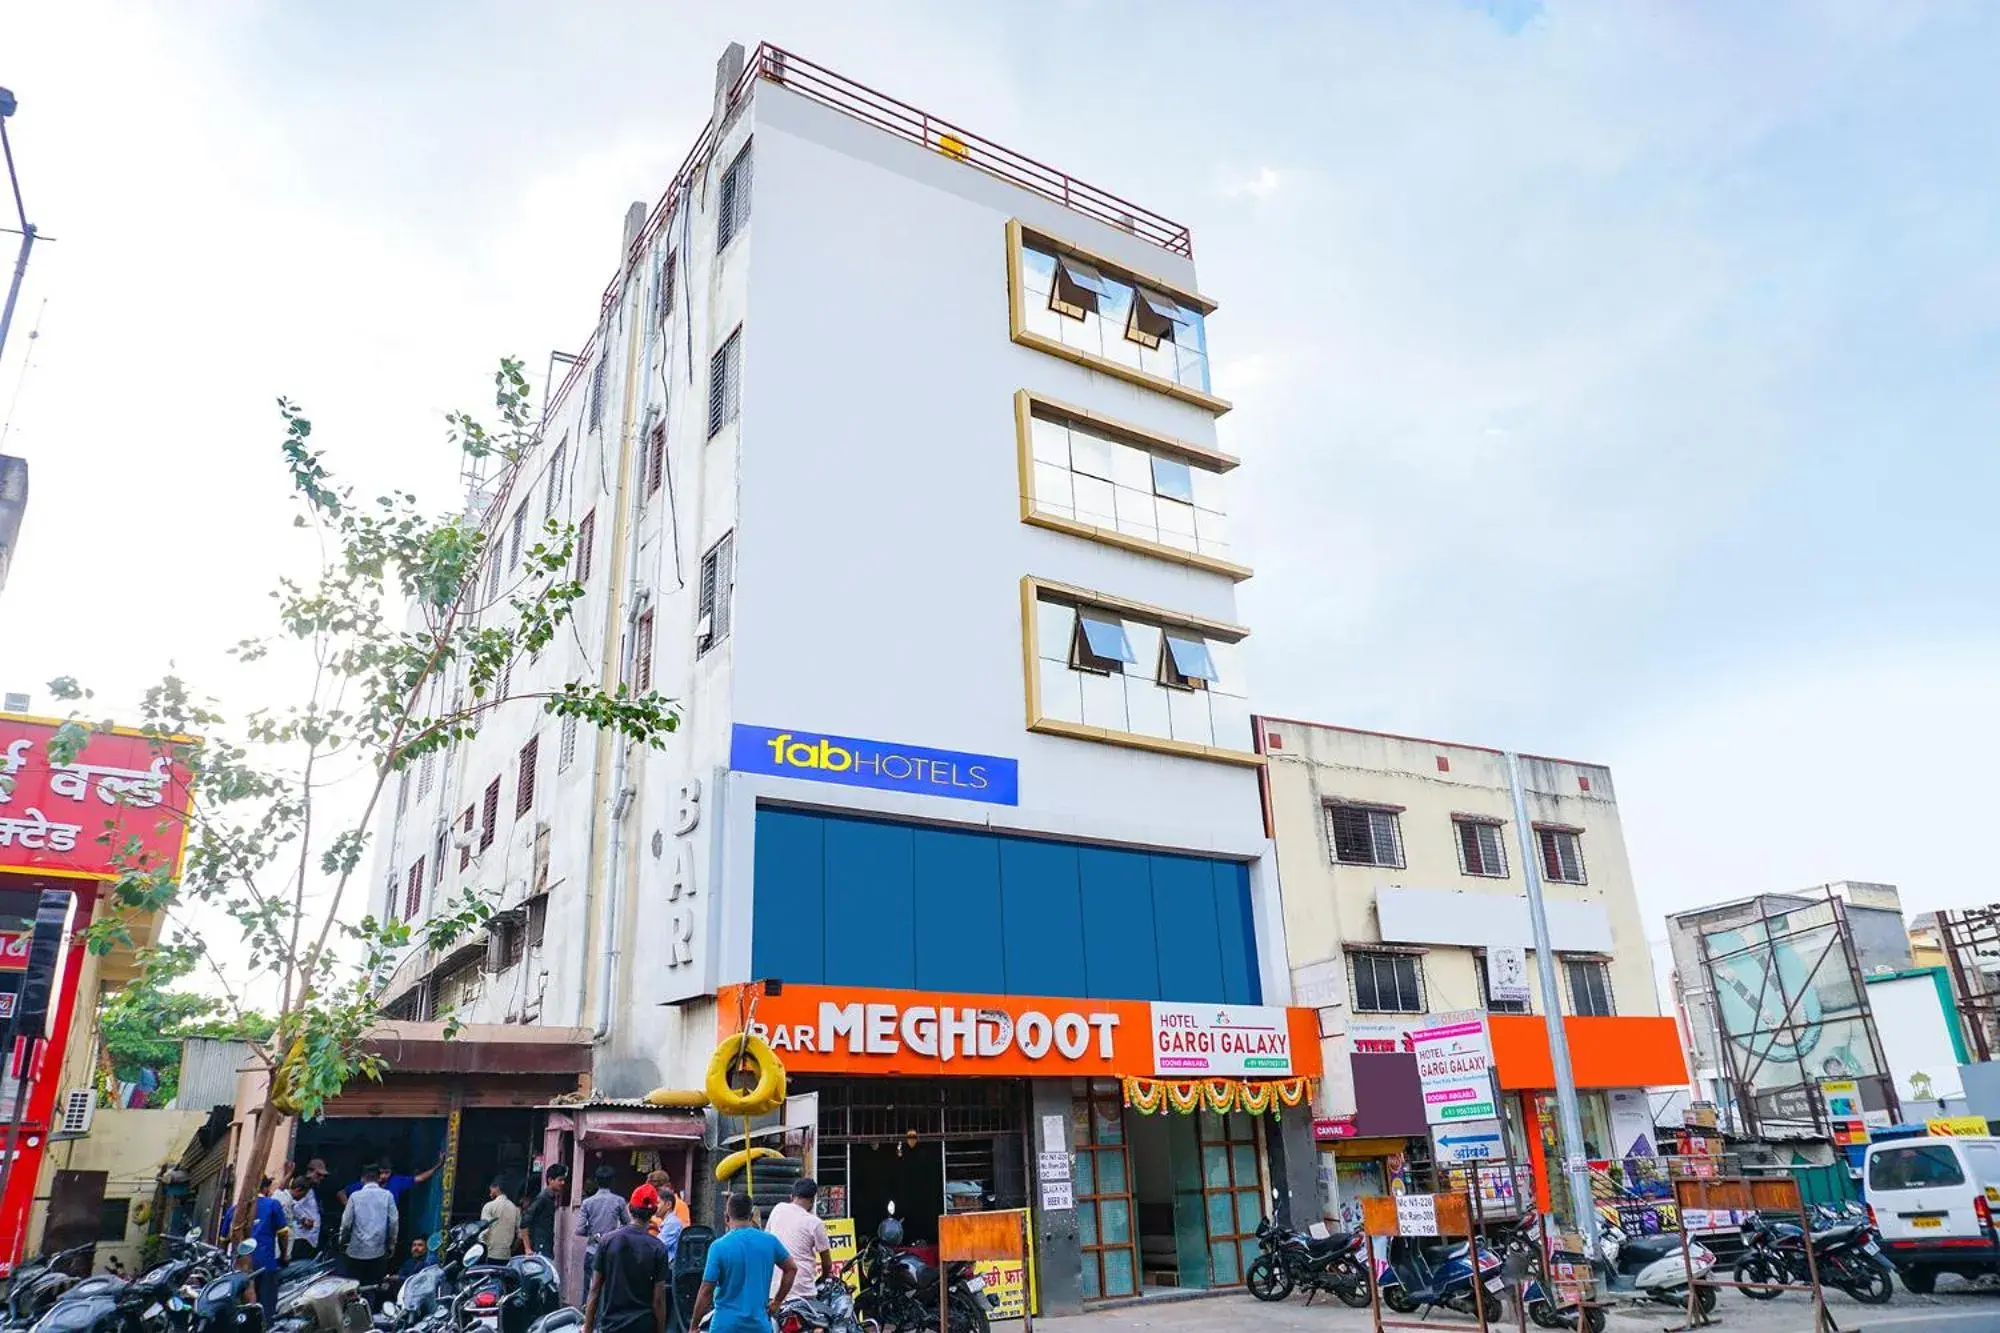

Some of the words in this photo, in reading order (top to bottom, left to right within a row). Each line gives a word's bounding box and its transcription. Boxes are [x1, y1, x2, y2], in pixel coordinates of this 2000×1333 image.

[667, 777, 701, 968] BAR
[1160, 1014, 1199, 1028] HOTEL
[750, 1018, 815, 1051] BAR
[818, 1002, 1120, 1062] MEGHDOOT
[1159, 1031, 1216, 1053] GARGI
[1221, 1033, 1287, 1054] GALAXY
[1419, 1048, 1445, 1059] HOTEL
[1421, 1062, 1448, 1077] GARGI
[1449, 1056, 1486, 1073] GALAXY
[1317, 1127, 1343, 1135] CANVAS
[1953, 1126, 1985, 1136] MOBILE
[1401, 1224, 1412, 1233] OC
